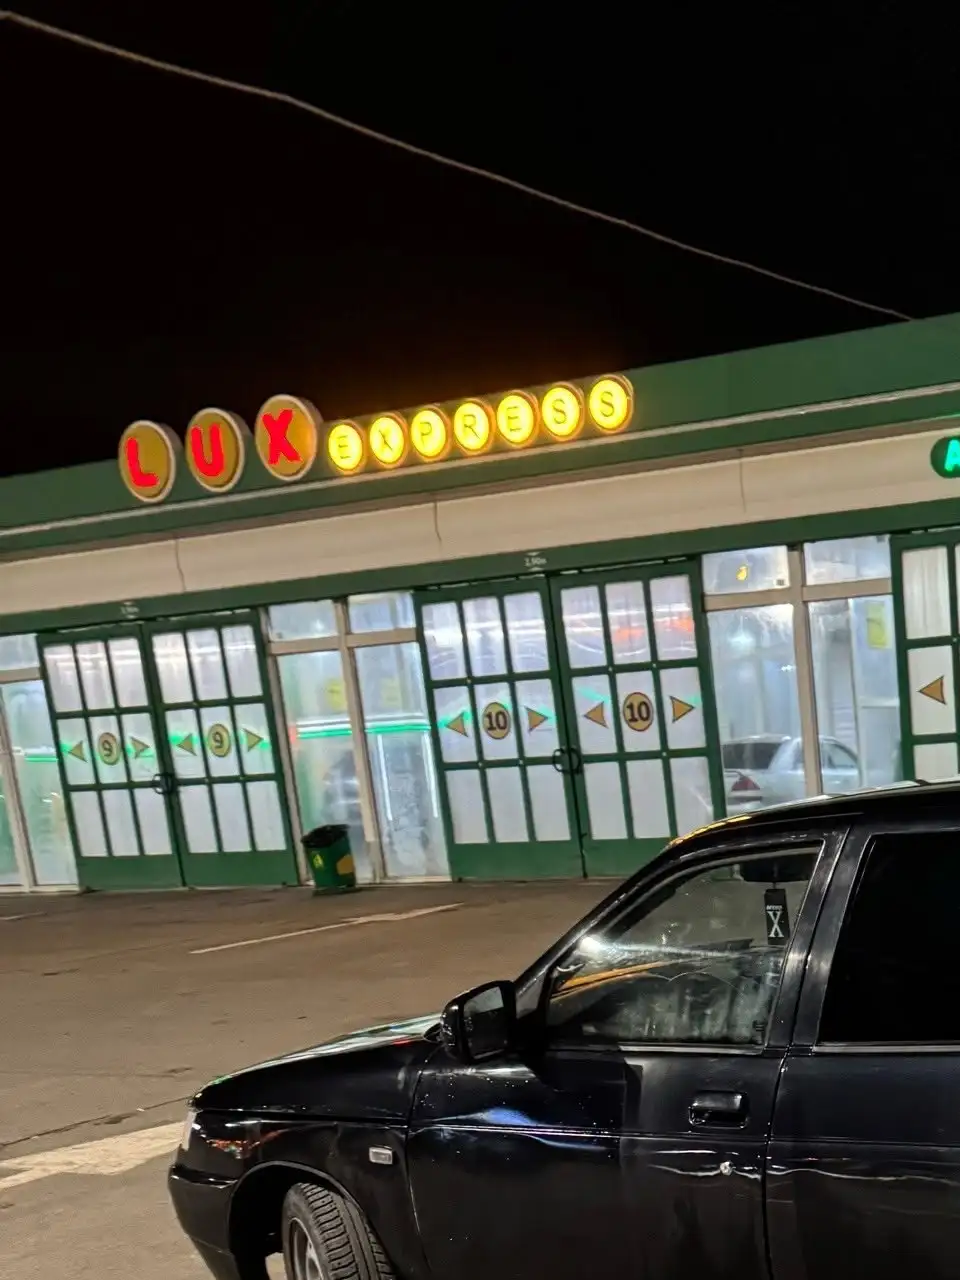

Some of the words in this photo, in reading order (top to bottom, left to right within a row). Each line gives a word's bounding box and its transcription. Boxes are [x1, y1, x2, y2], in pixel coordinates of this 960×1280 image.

[124, 409, 302, 488] LUX
[337, 390, 617, 460] EXPRESS
[485, 711, 508, 731] 10
[626, 701, 651, 723] 10
[101, 739, 113, 758] 9
[211, 731, 224, 749] 9
